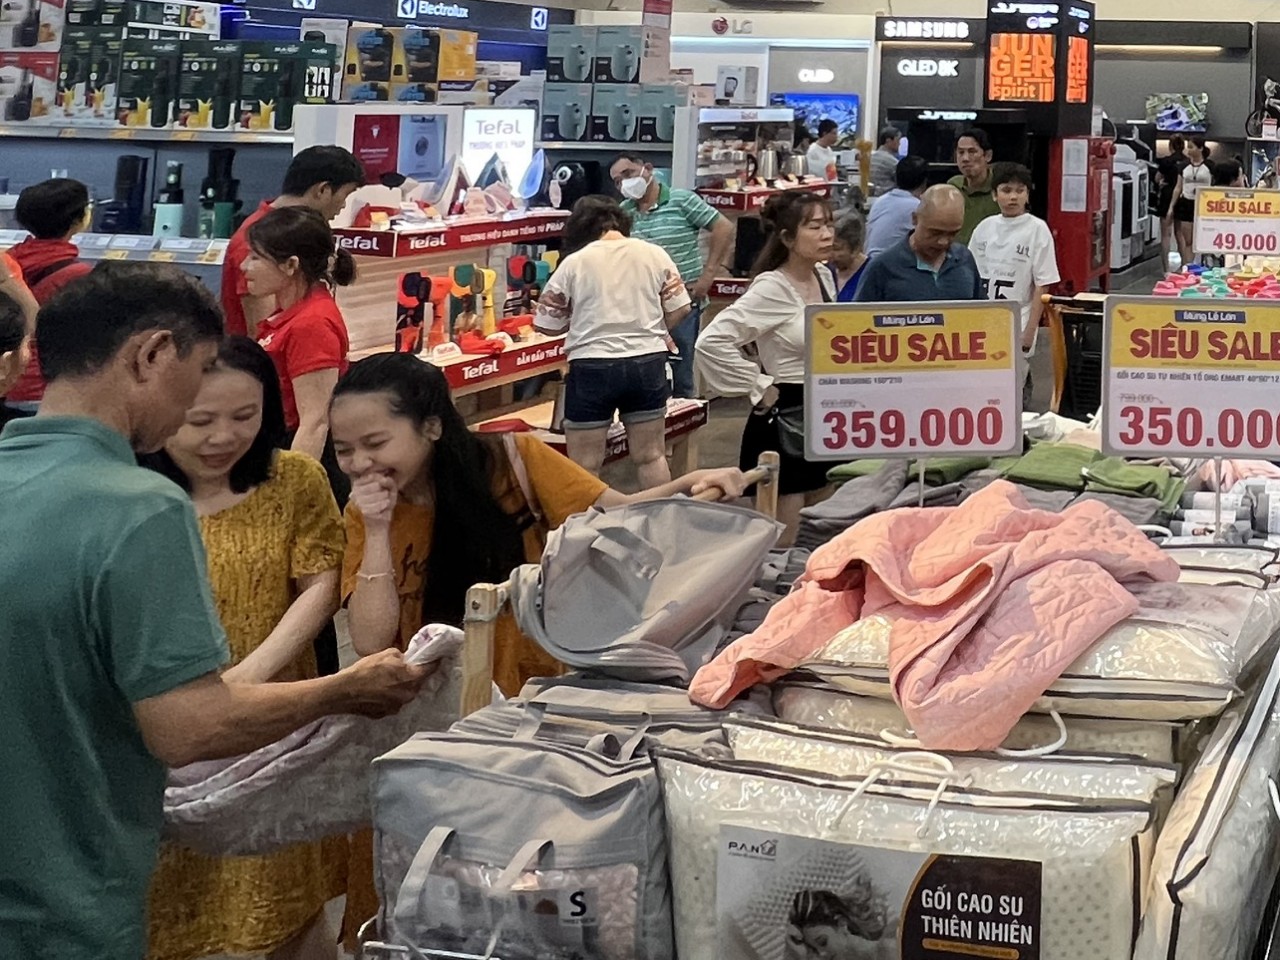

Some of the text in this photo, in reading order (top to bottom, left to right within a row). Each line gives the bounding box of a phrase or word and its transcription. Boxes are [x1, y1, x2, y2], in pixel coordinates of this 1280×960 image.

[418, 0, 469, 18] Electrolux
[732, 19, 753, 34] LG
[884, 20, 969, 39] SAMSUNG
[897, 58, 938, 77] QLED
[476, 119, 521, 135] Tefal
[1206, 198, 1272, 215] SIÊU SALE
[333, 234, 380, 251] Tefal
[409, 233, 447, 250] Tefal
[1212, 233, 1277, 251] 49.000
[716, 283, 747, 295] Tefa
[830, 328, 987, 364] SIÊU SALE
[1129, 322, 1199, 360] SIÊU
[462, 359, 500, 380] Tefal
[1220, 373, 1245, 383] EMART
[822, 406, 1003, 450] 359.000
[569, 890, 587, 917] S
[921, 884, 1024, 917] GỐI CAO SU
[921, 914, 1033, 945] THIÊN NHIÊN
